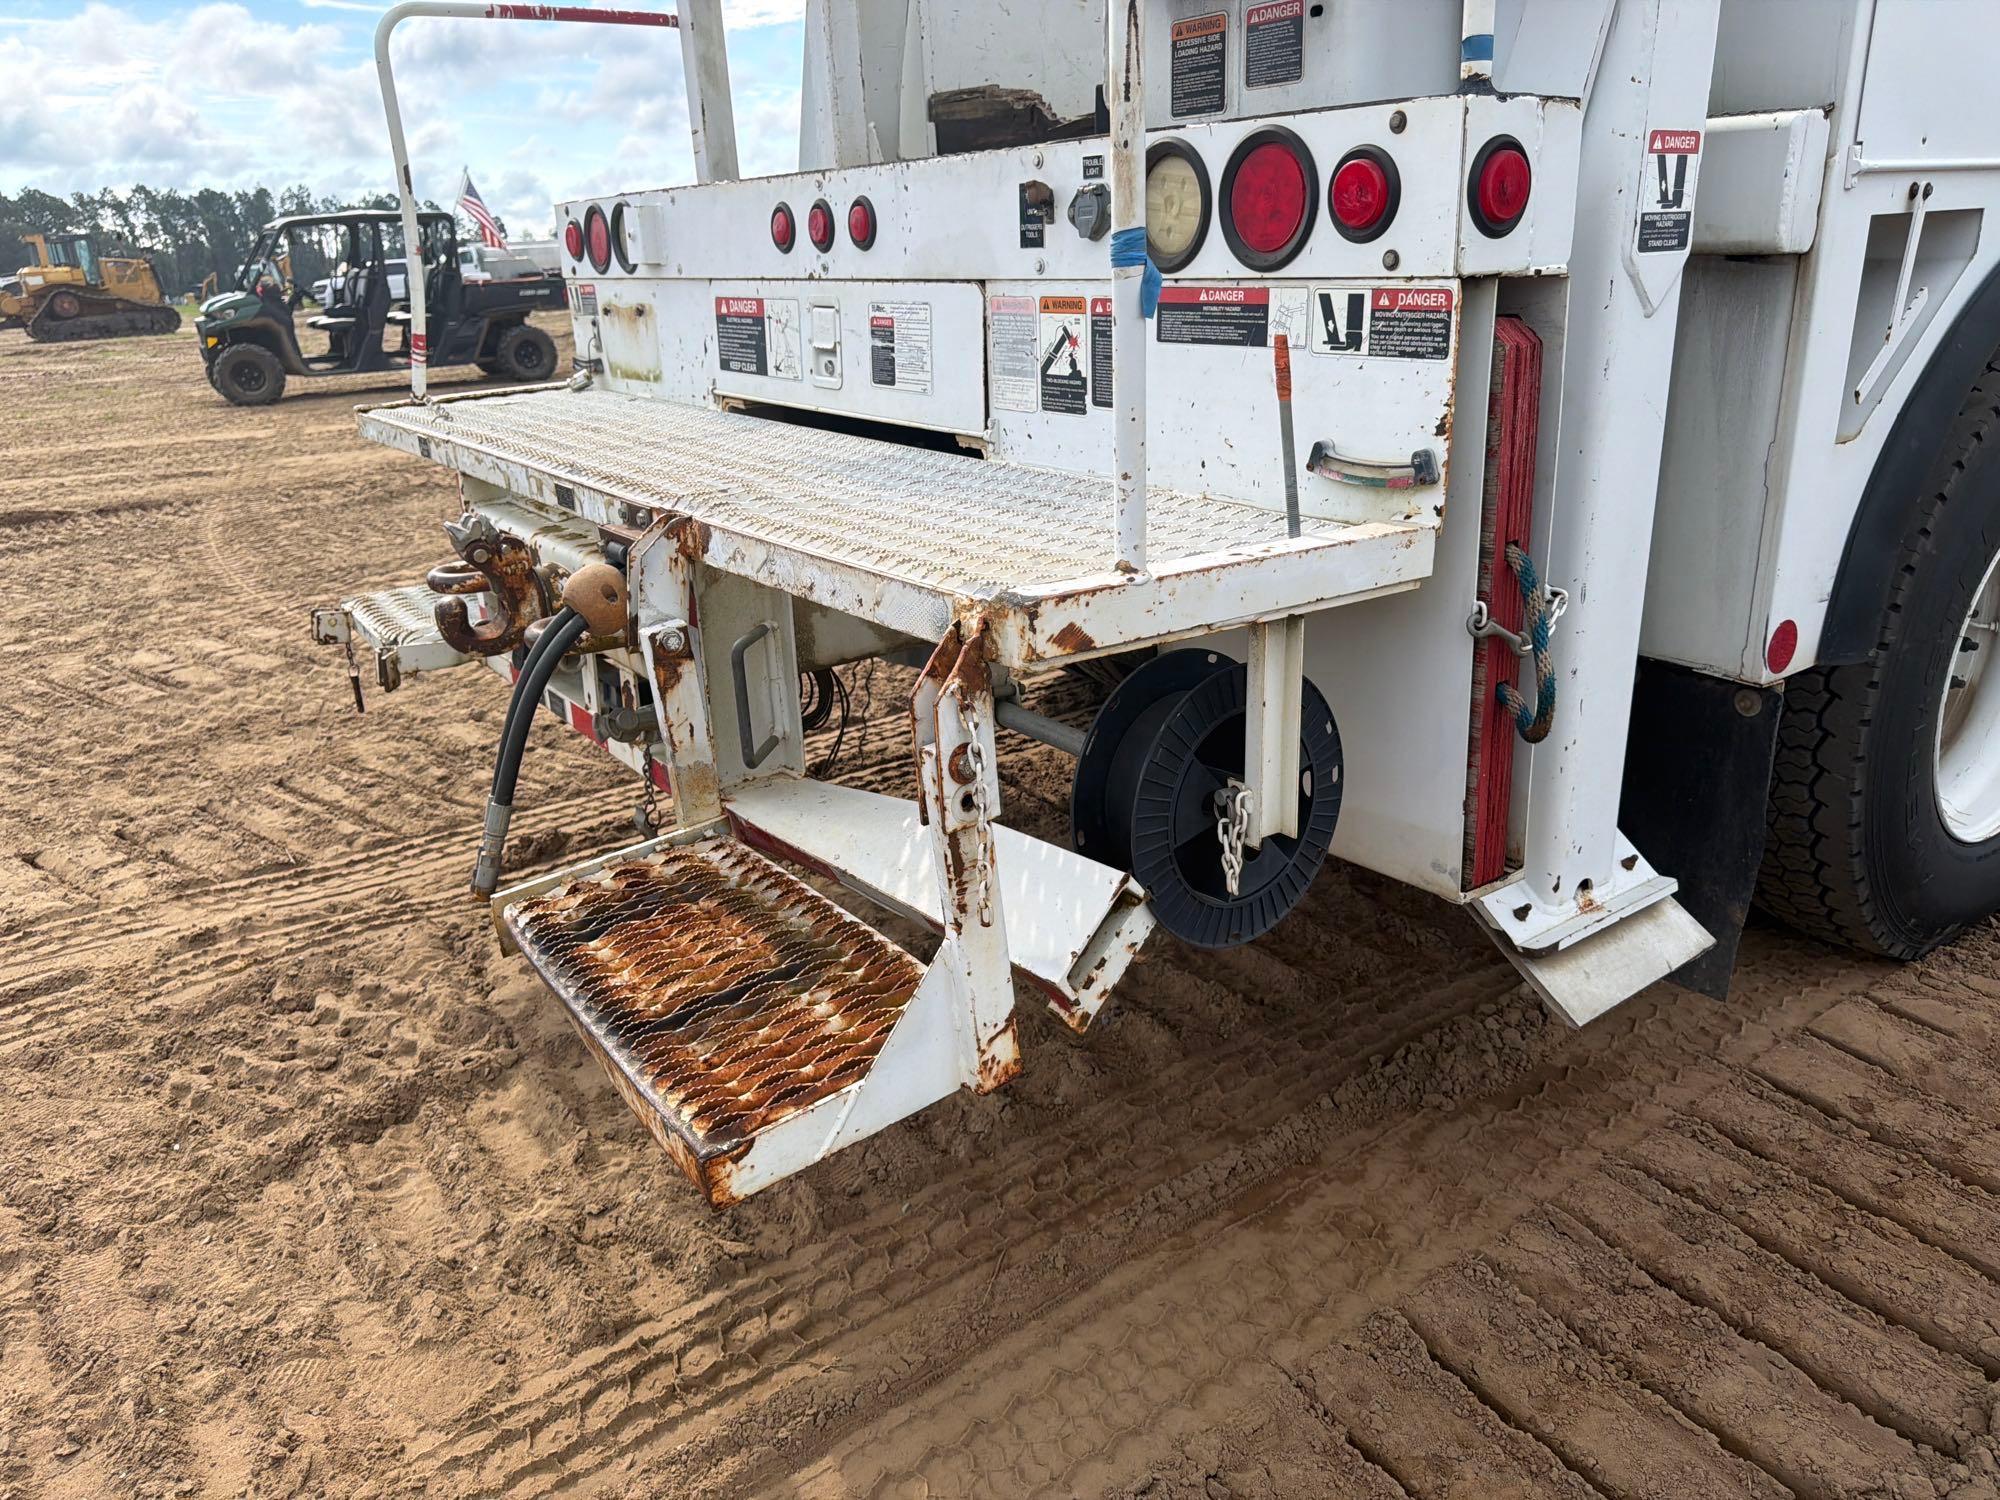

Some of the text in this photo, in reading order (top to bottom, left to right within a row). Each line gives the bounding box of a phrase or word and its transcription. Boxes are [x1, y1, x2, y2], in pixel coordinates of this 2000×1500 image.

[1260, 2, 1300, 21] DANGER
[1186, 19, 1221, 33] WARNING
[1176, 34, 1220, 48] EXCESSIVE SIDE
[1174, 43, 1222, 58] LOADING HAZARD
[1664, 136, 1695, 149] DANGER
[1083, 158, 1103, 166] TROUBLE
[1086, 167, 1099, 176] LIGHT
[1648, 238, 1678, 247] STAND CLEAR
[1209, 290, 1244, 301] DANGER
[1398, 293, 1446, 306] DANGER
[729, 299, 758, 314] DANGER
[1052, 300, 1082, 310] WARNING
[729, 361, 758, 373] KEEP CLEAR
